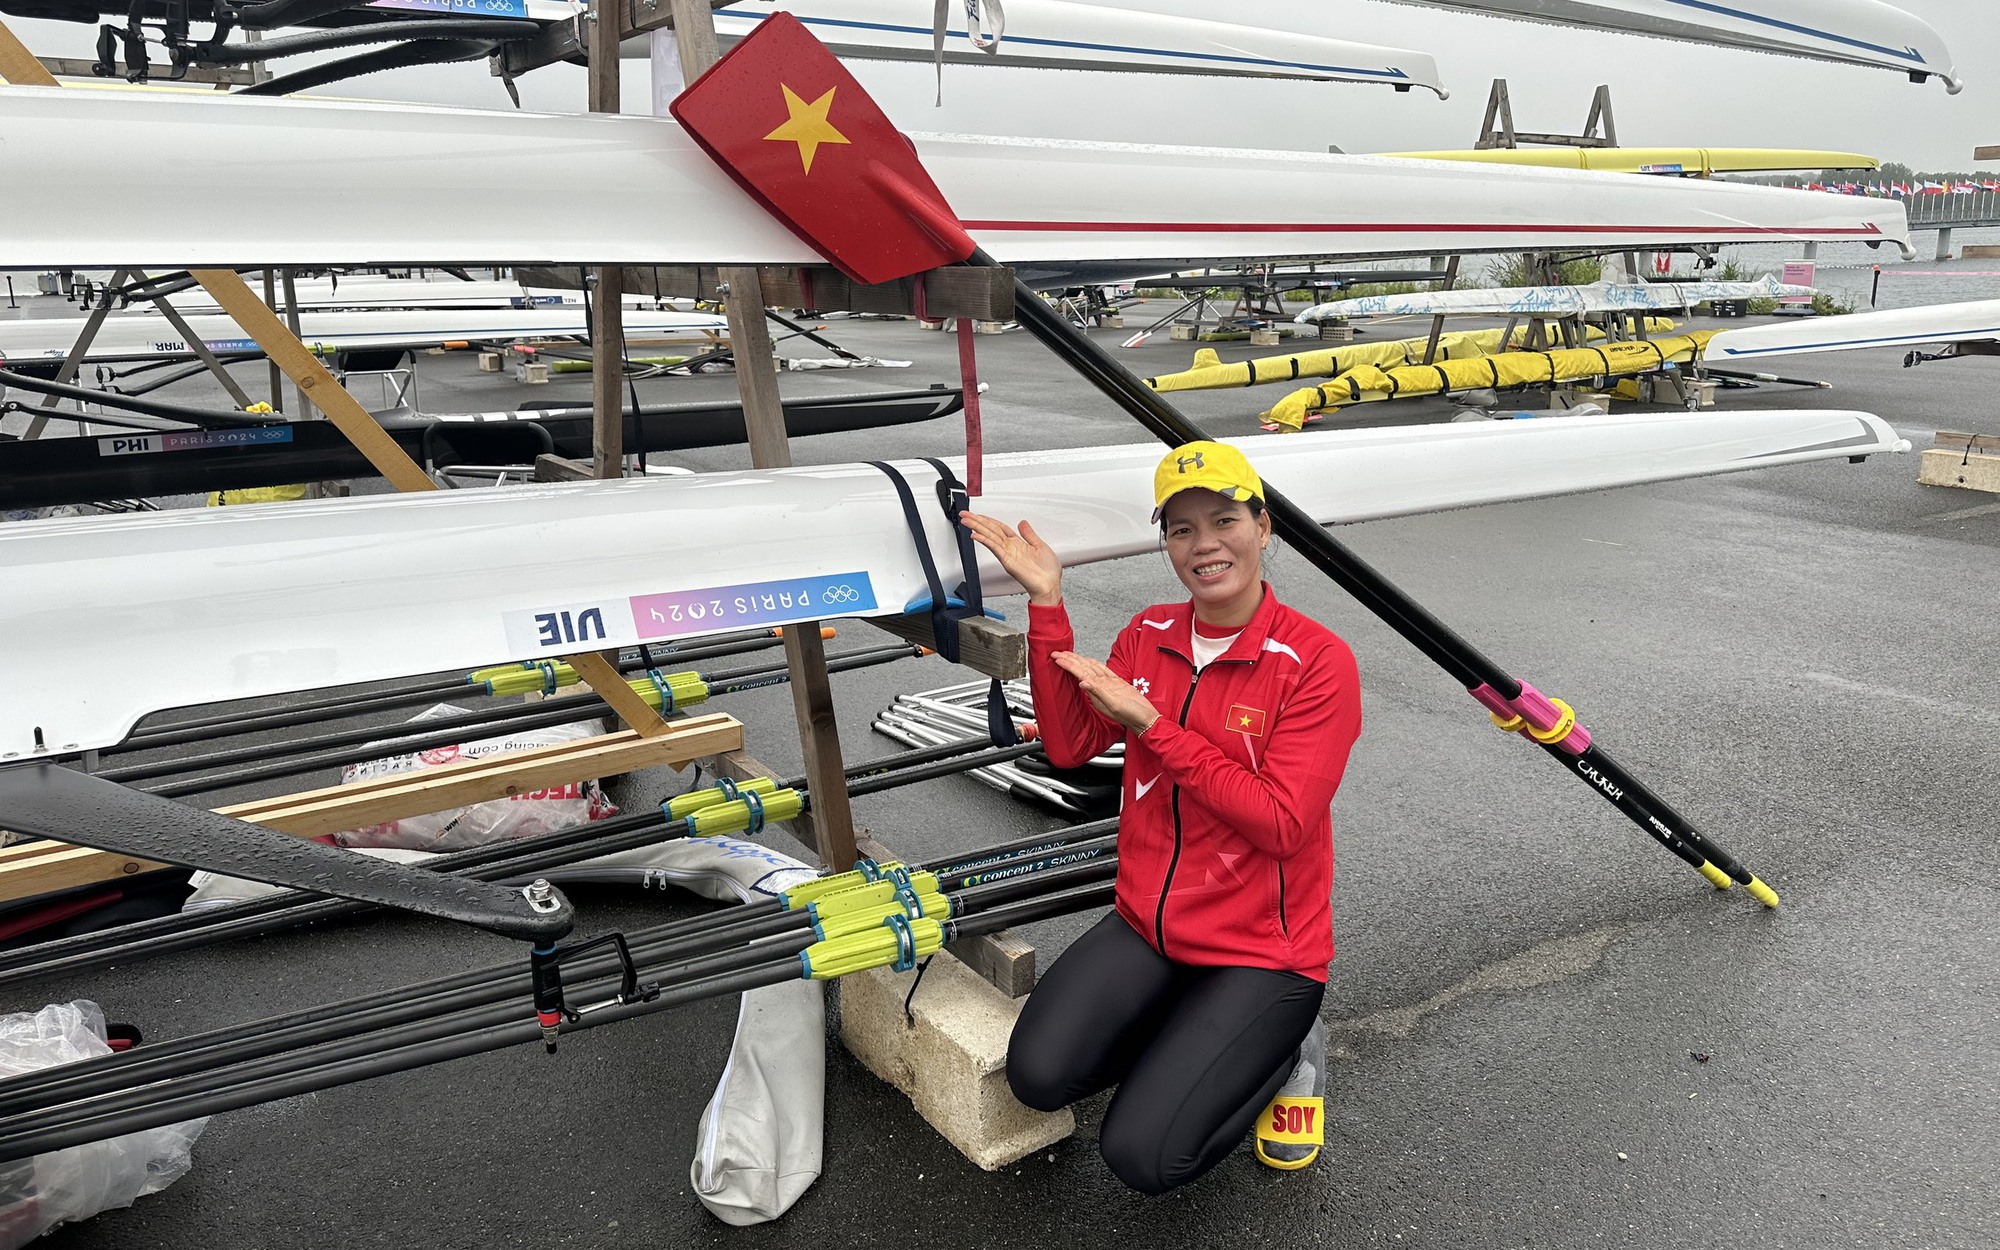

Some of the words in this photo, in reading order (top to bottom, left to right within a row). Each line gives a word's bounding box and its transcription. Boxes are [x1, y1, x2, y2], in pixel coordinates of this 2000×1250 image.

[155, 342, 185, 351] MAR
[112, 438, 149, 452] PHI
[535, 607, 606, 646] VIE
[983, 864, 1033, 882] concept
[1037, 861, 1044, 870] 2
[1050, 849, 1099, 867] SKINNY
[1272, 1104, 1316, 1134] SOY
